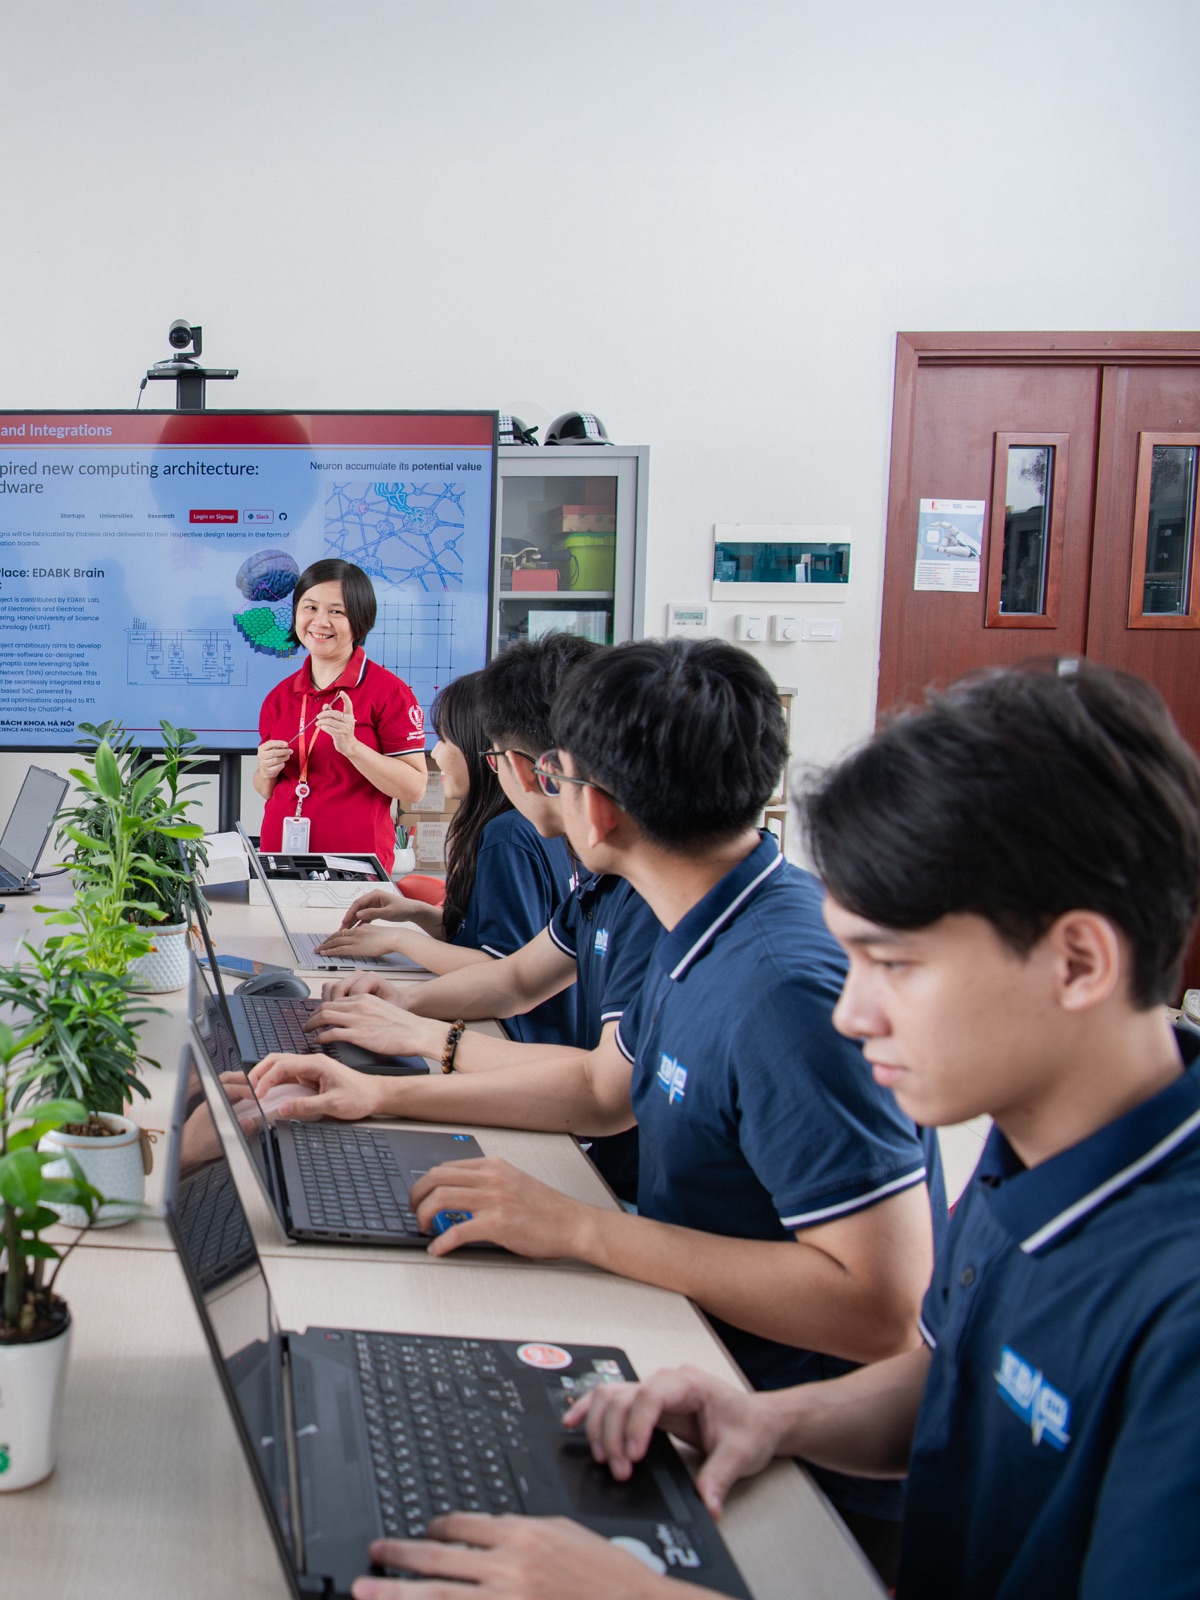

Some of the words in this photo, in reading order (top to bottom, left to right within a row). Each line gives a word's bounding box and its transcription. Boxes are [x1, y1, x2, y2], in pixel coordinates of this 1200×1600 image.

[0, 424, 26, 436] and
[30, 424, 112, 439] Integrations
[42, 465, 74, 475] new
[78, 461, 159, 479] computing
[163, 461, 259, 475] architecture:
[310, 462, 343, 470] Neuron
[345, 462, 397, 471] accumulate
[398, 462, 410, 471] its
[412, 462, 454, 473] potential
[456, 462, 482, 471] value
[66, 531, 75, 539] by
[203, 531, 226, 539] design
[32, 568, 71, 578] EDABK
[73, 567, 105, 578] Brain
[36, 615, 67, 623] University
[76, 643, 102, 651] develop
[44, 652, 85, 660] co-designed
[38, 661, 72, 669] leveraging
[25, 668, 44, 677] (SNN)
[49, 679, 82, 687] integrated
[64, 688, 73, 696] by
[10, 697, 52, 705] optimizations
